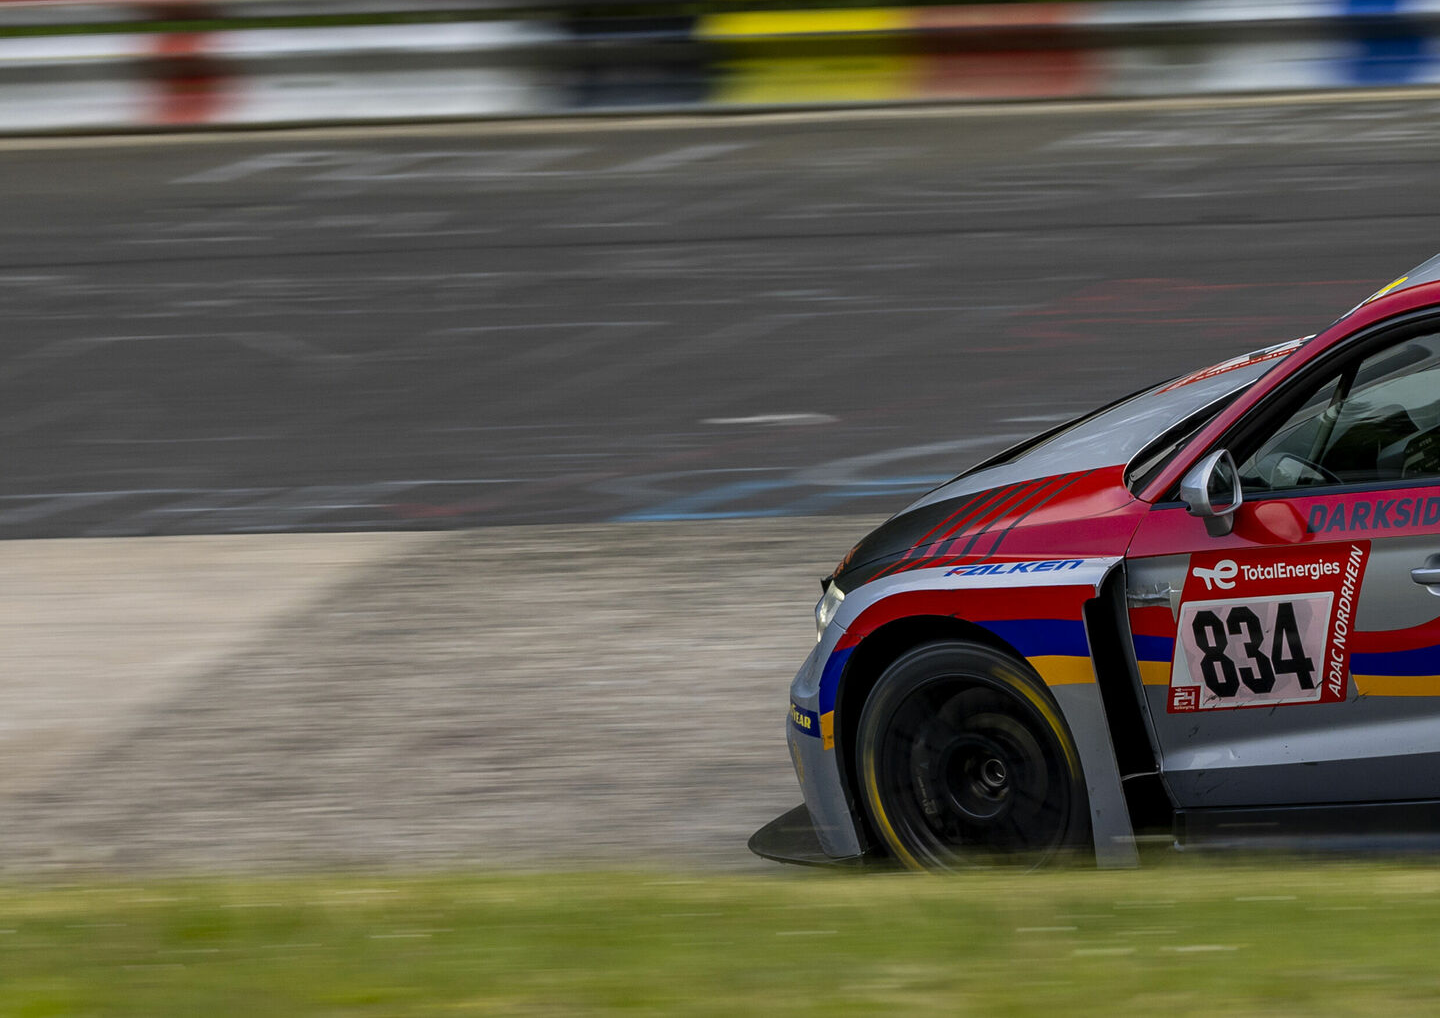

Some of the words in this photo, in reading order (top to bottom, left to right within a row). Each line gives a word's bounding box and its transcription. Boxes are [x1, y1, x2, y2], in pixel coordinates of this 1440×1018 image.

[943, 559, 1085, 577] FALKEN
[1240, 559, 1341, 580] TotalEnergies
[1332, 544, 1364, 650] NORDRHEIN
[1192, 602, 1315, 698] 834
[1328, 649, 1344, 698] ADAC
